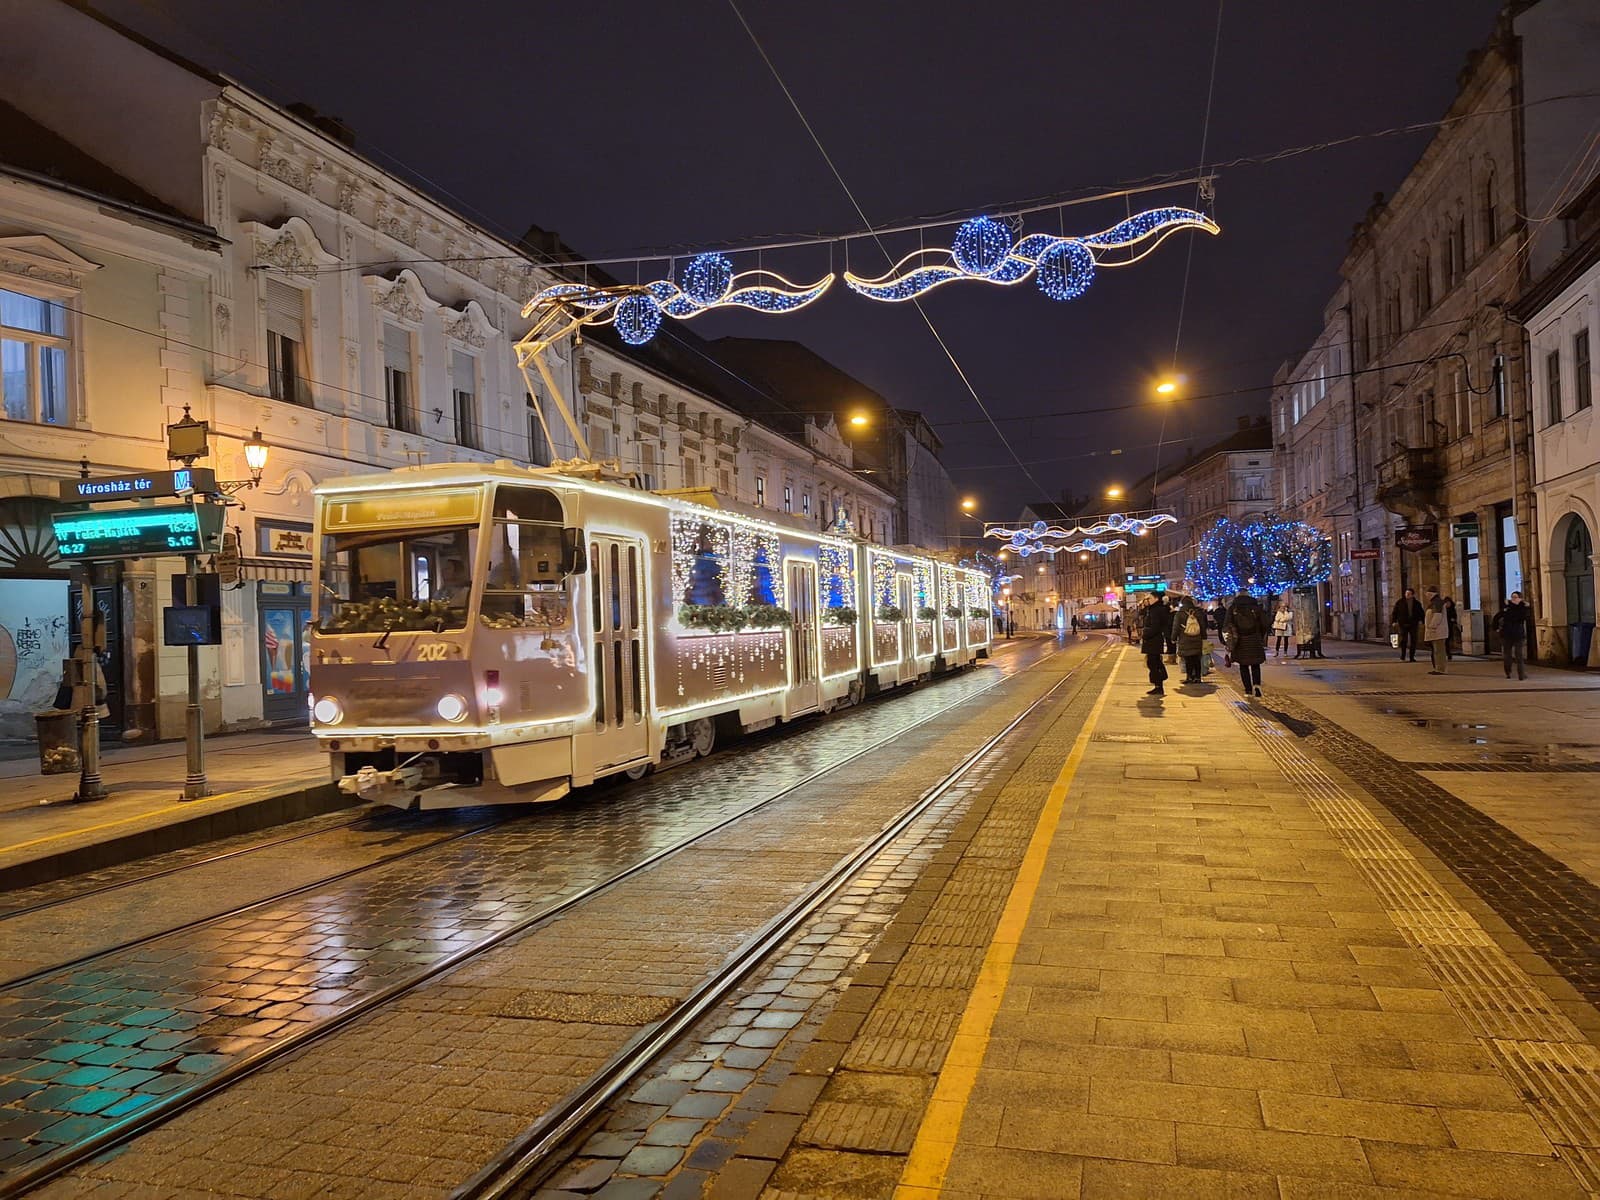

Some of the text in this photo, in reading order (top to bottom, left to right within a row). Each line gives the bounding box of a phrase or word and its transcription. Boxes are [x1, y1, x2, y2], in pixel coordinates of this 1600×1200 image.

[78, 482, 131, 495] Városház
[134, 479, 151, 490] tér
[338, 503, 349, 524] 1
[417, 643, 448, 661] 202
